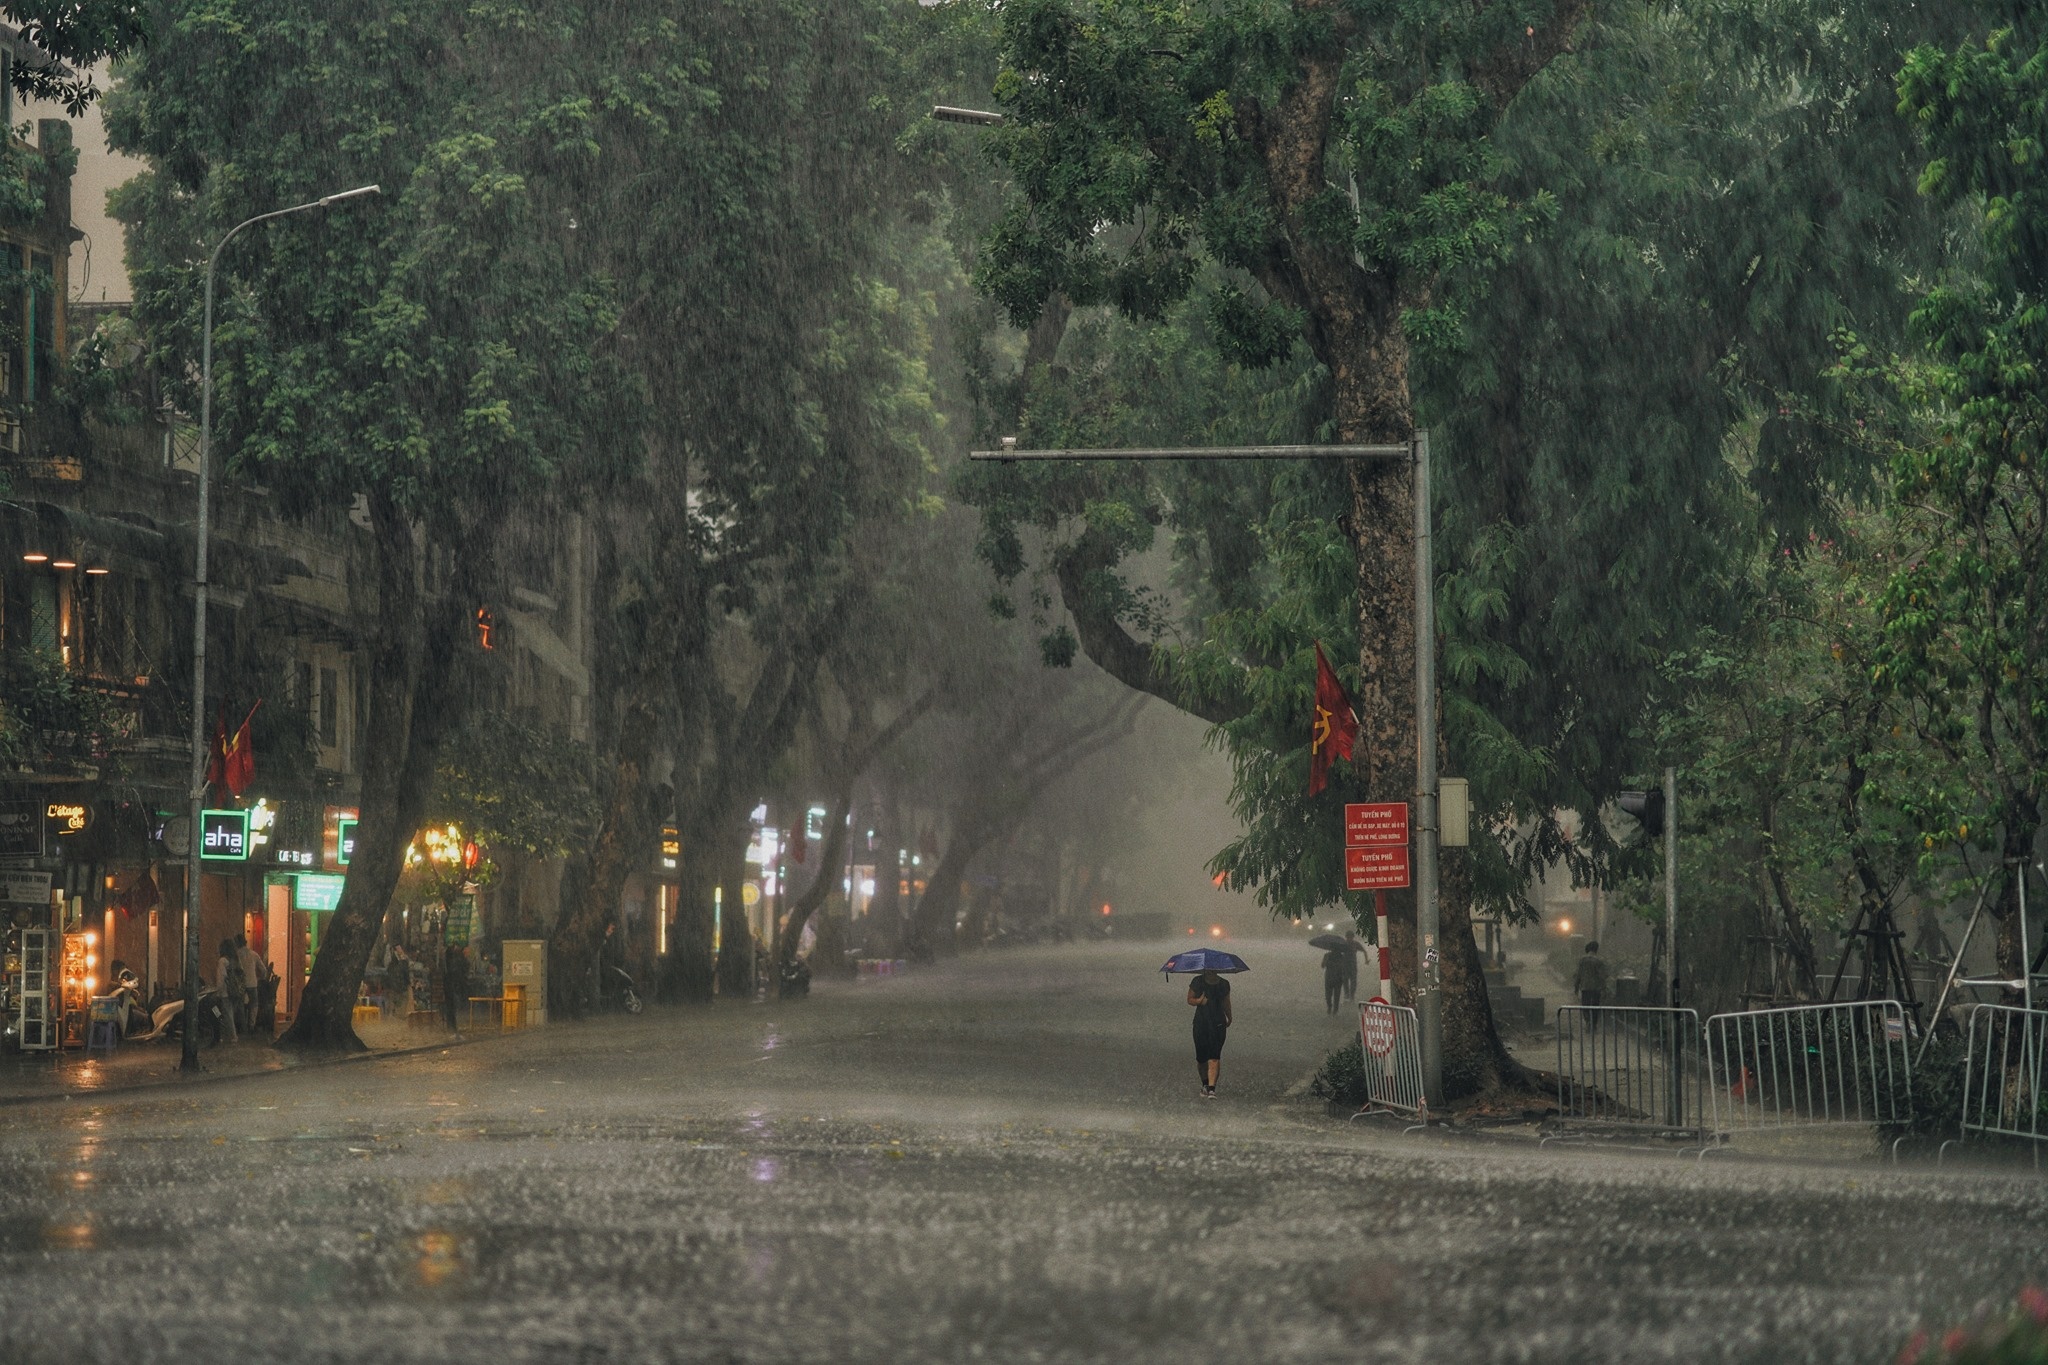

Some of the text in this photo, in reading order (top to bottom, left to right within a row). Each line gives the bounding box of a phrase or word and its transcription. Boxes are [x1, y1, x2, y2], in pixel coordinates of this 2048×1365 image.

[47, 804, 85, 819] L'étage
[1380, 809, 1392, 818] PHỐ
[204, 825, 243, 846] aha
[1362, 853, 1392, 862] TUYẾN PHỐ
